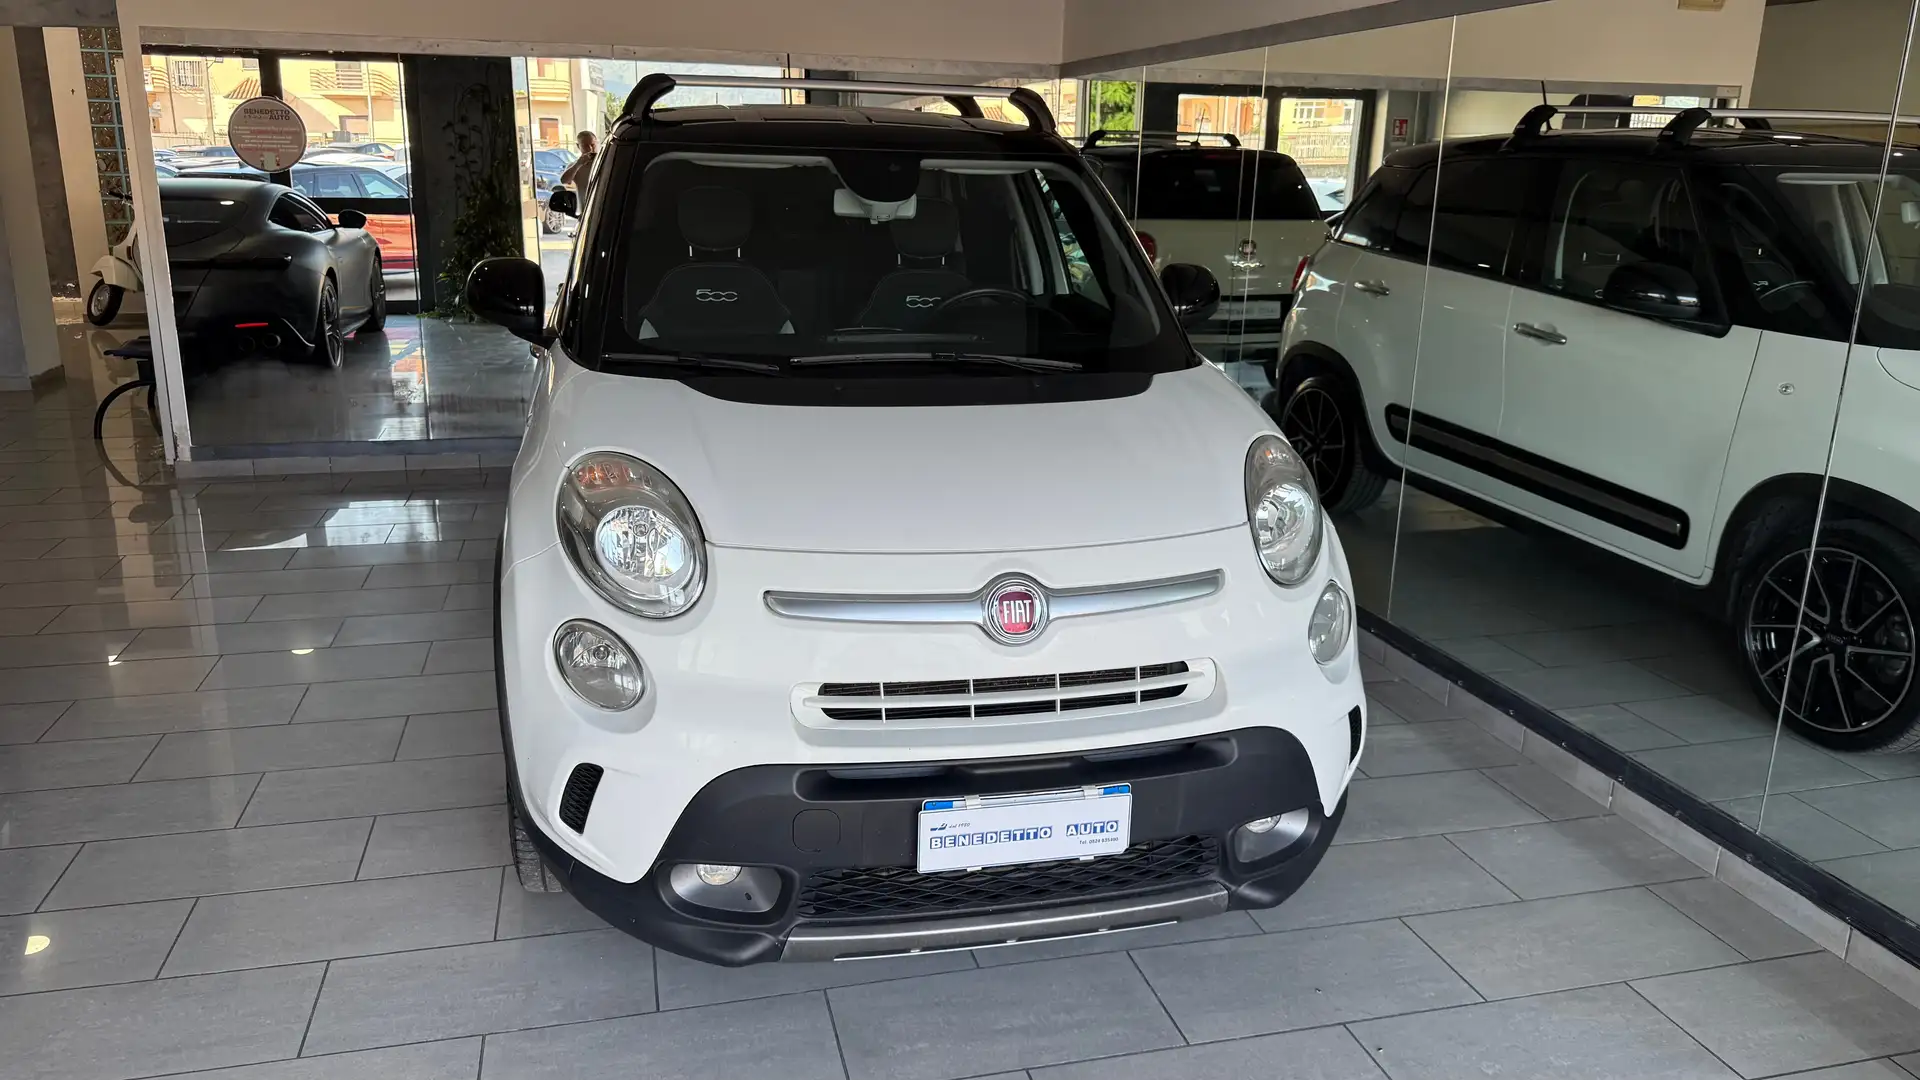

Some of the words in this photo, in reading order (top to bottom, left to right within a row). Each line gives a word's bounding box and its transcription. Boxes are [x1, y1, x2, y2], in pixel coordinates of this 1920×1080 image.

[696, 289, 738, 301] 500
[1002, 600, 1032, 624] FIAT
[930, 826, 1052, 849] BENEDETTO
[1066, 820, 1118, 837] AUTO
